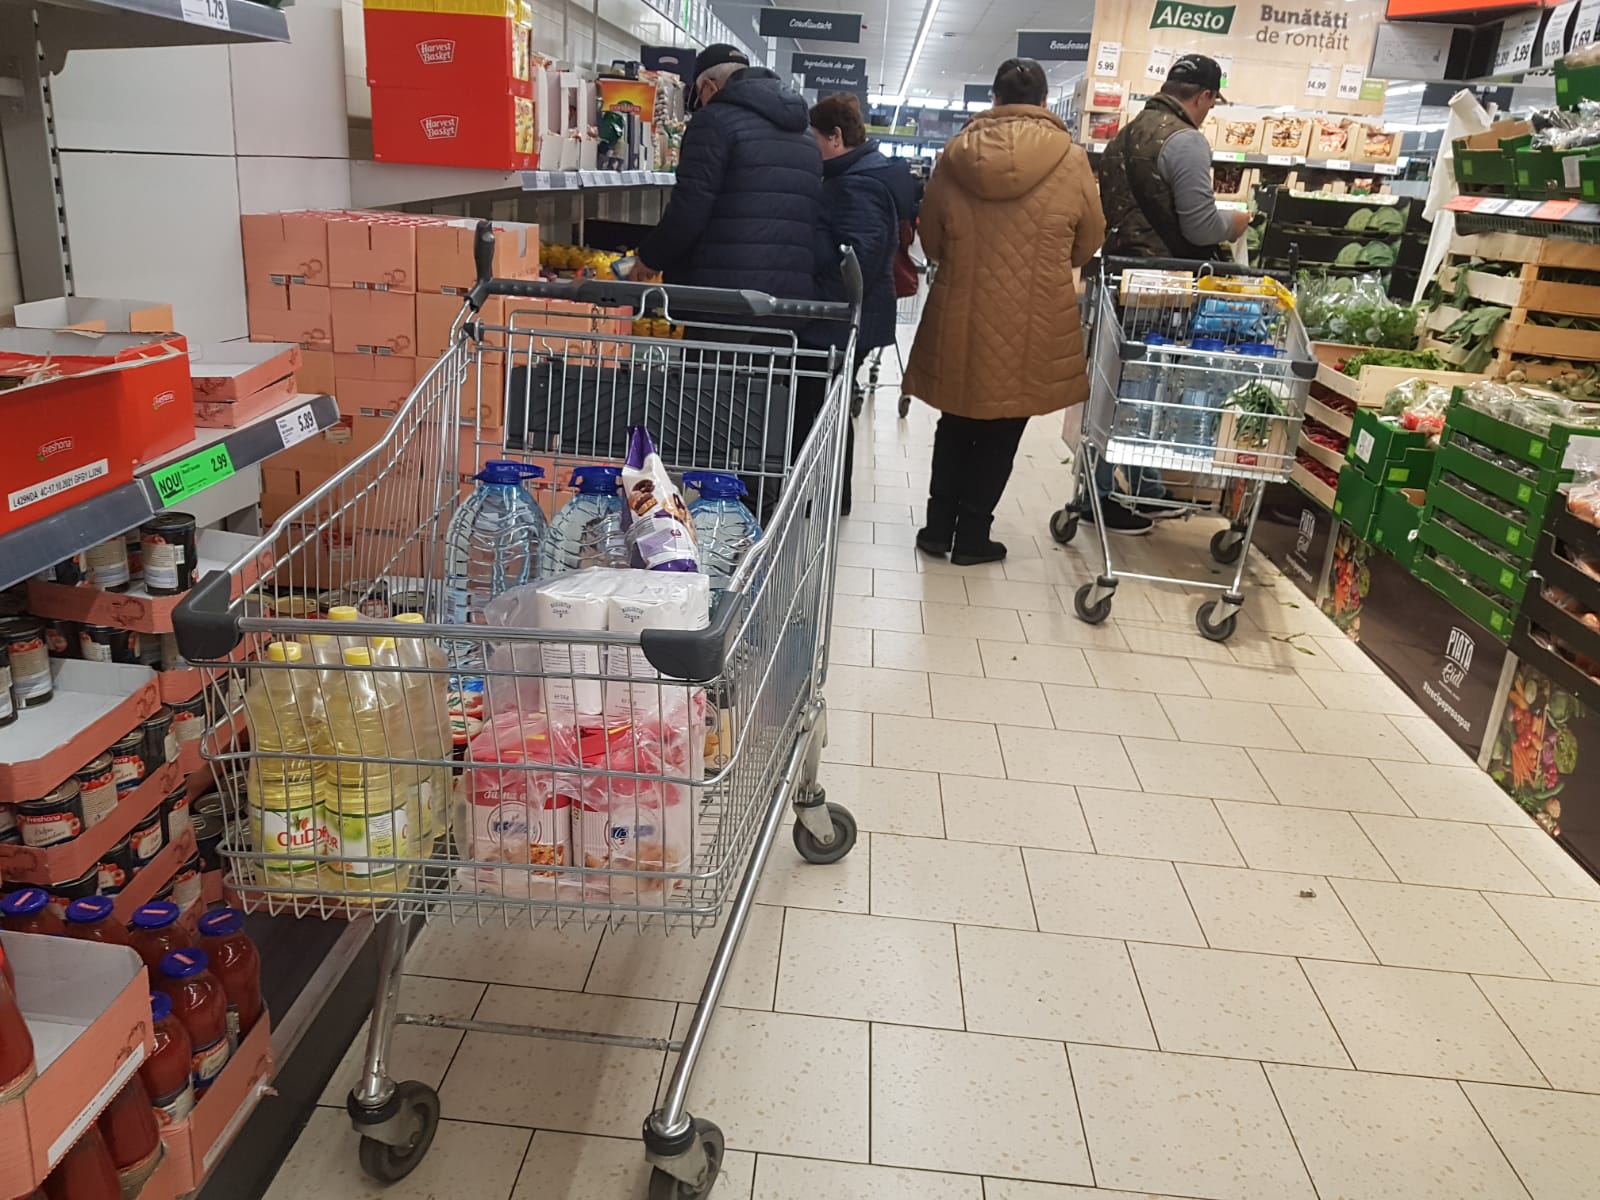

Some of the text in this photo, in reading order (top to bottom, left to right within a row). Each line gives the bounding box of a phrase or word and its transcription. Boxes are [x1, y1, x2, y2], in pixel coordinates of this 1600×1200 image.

[1156, 5, 1225, 30] Alesto
[1260, 4, 1348, 32] Bunătăți
[421, 43, 451, 53] Harvest
[1256, 26, 1350, 52] de ronțăit
[423, 51, 451, 62] Basket
[1097, 60, 1115, 71] 5.99
[425, 119, 455, 129] Harvest
[427, 127, 455, 138] Basket
[298, 411, 314, 432] 5.89
[41, 438, 73, 456] Freshona
[211, 452, 228, 473] 2.99
